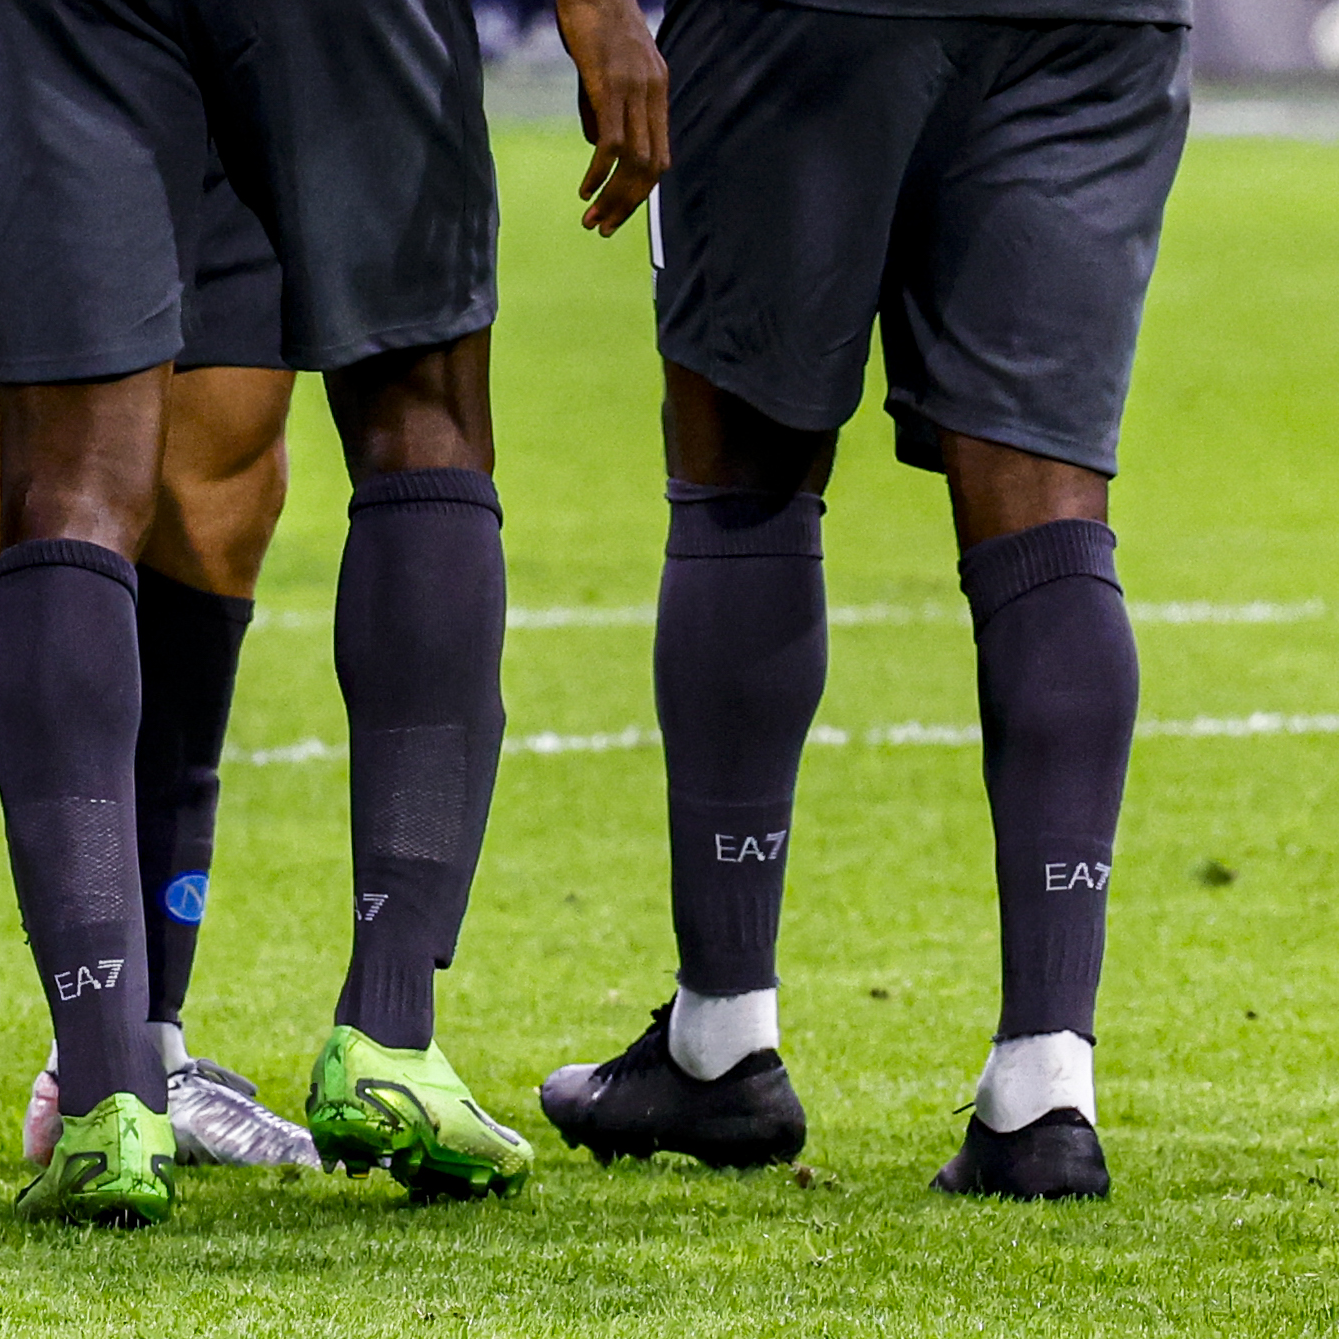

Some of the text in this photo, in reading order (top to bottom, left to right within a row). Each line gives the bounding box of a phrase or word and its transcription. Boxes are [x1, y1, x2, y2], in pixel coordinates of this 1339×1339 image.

[715, 828, 788, 863] EA7
[1045, 861, 1113, 892] EA7
[54, 959, 125, 1001] EA7
